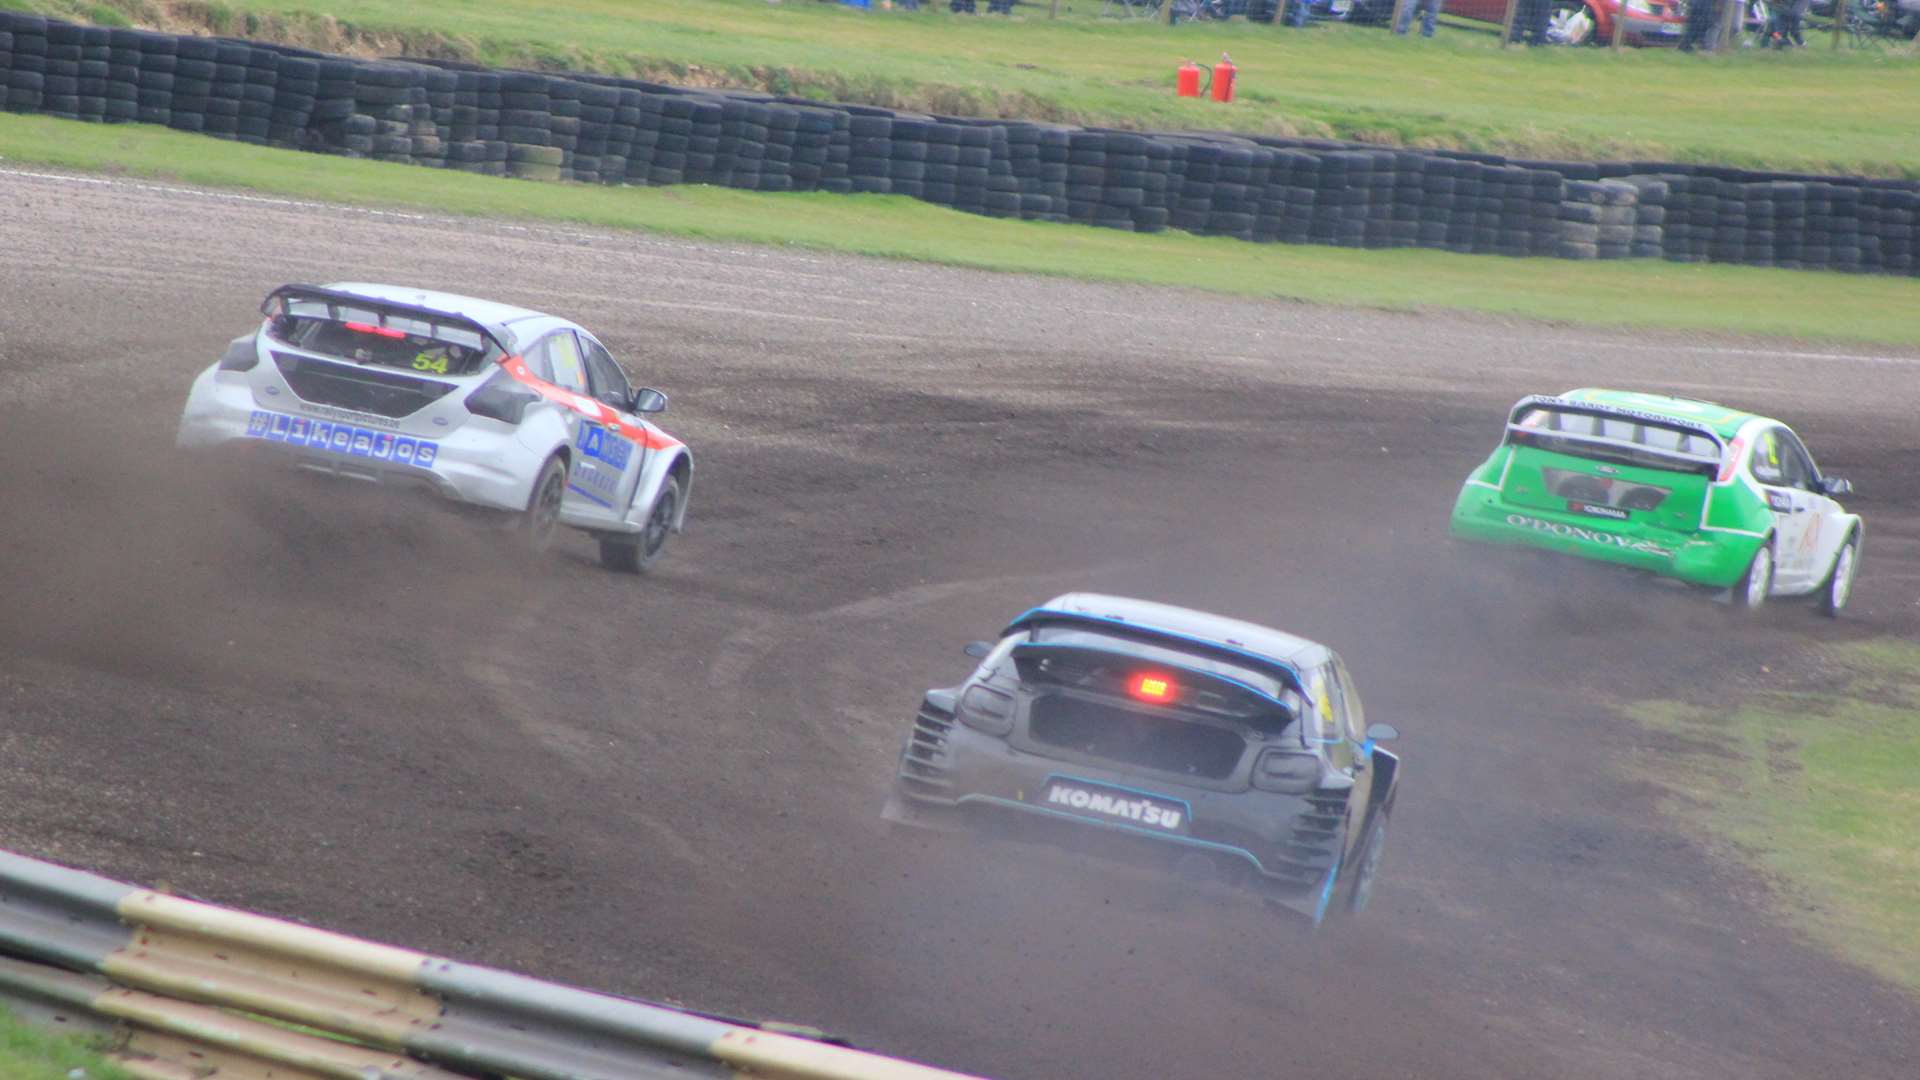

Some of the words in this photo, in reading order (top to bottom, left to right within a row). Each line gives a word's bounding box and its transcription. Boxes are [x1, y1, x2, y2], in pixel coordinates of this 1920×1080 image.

[412, 351, 448, 374] 54
[1615, 408, 1706, 429] MOTORSPORT
[249, 413, 435, 461] #Likeajos
[1048, 785, 1182, 829] KOMATSU
